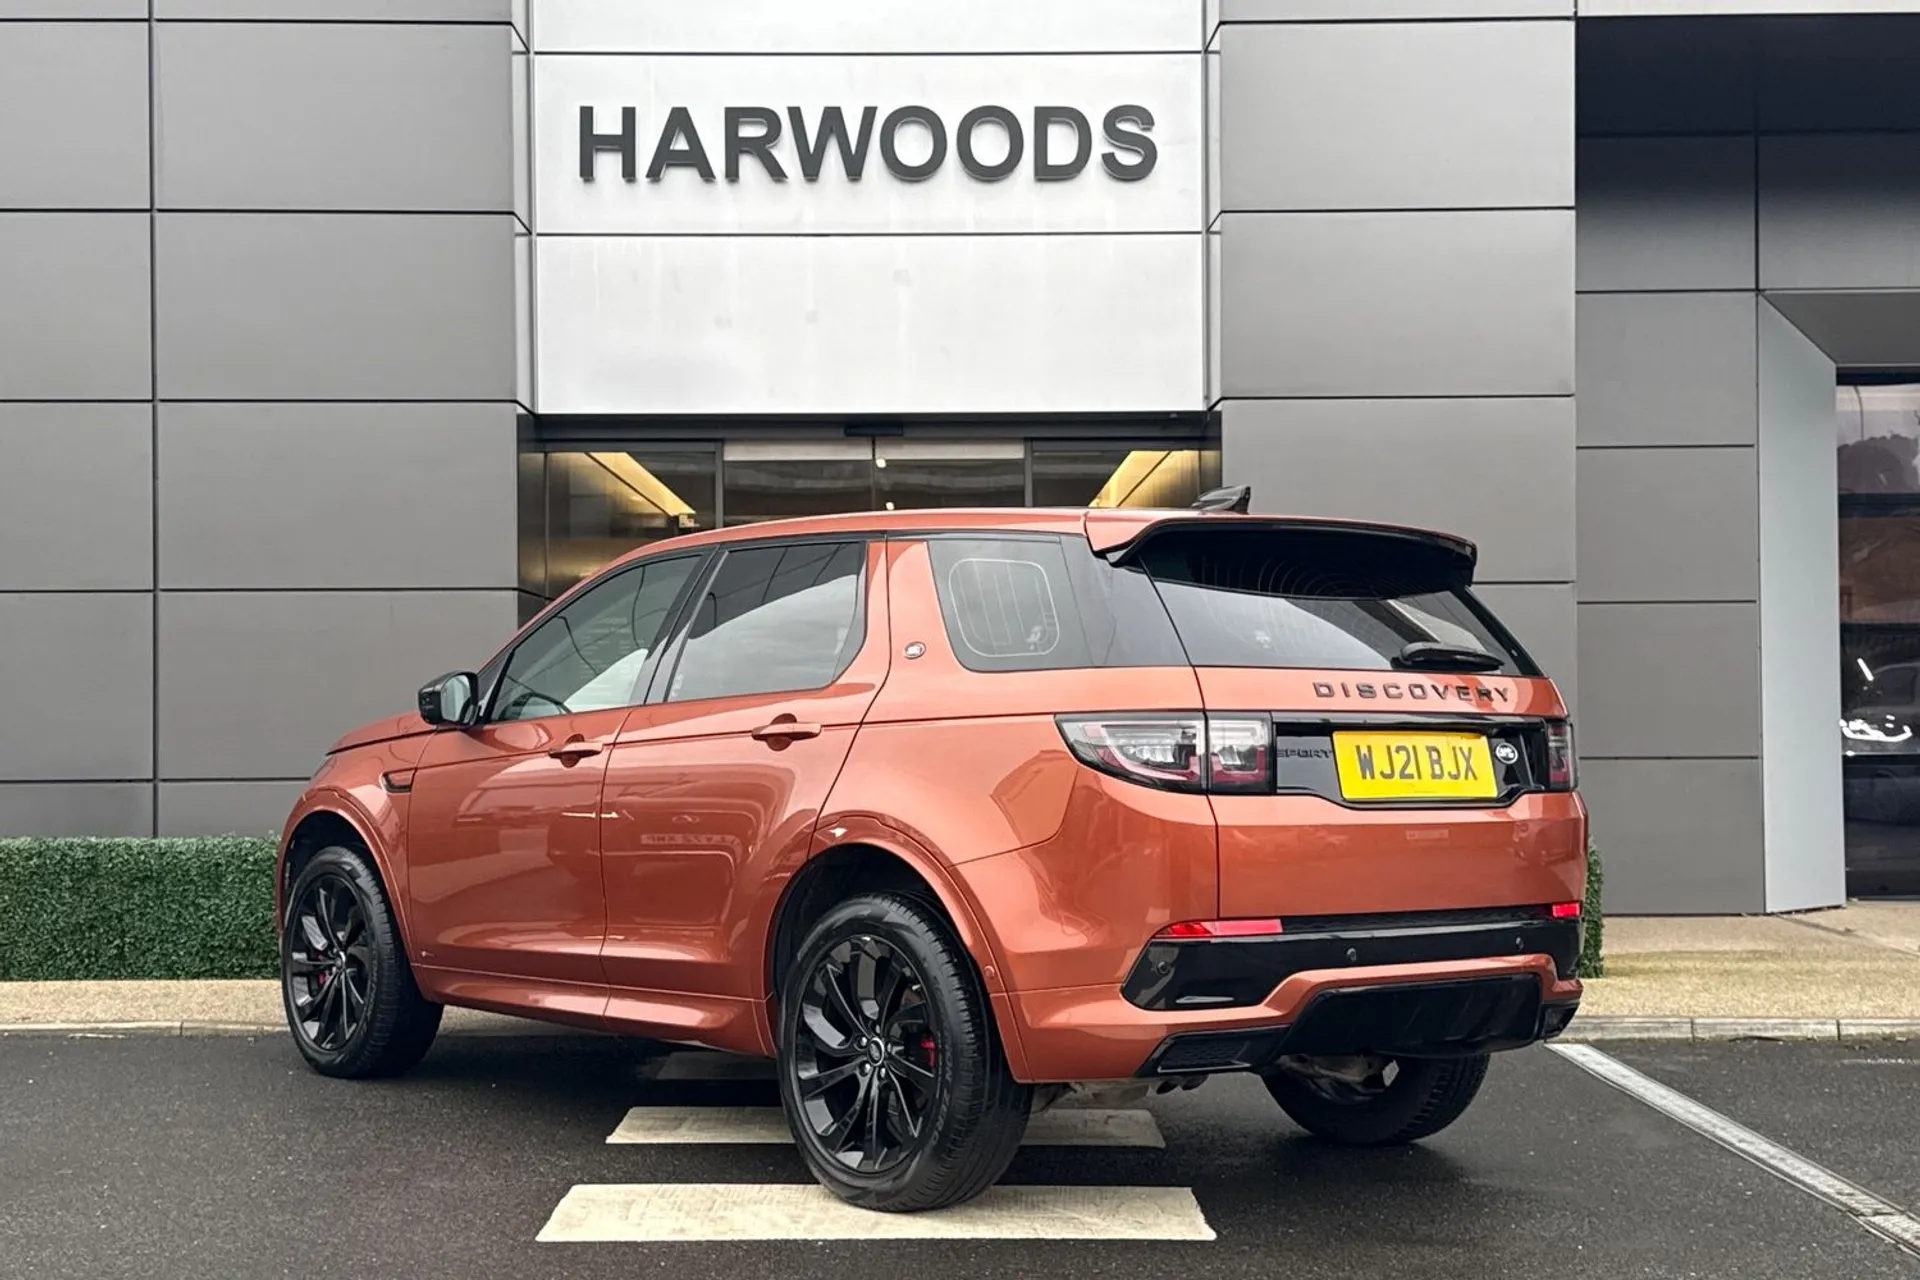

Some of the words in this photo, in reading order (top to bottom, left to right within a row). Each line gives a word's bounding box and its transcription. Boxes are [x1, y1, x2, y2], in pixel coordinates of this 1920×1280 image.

[579, 104, 1158, 183] HARWOODS
[1313, 682, 1510, 702] DISCOVERY
[1276, 747, 1333, 759] SPORT
[1355, 744, 1423, 780] WJ21
[1426, 746, 1478, 780] BJX
